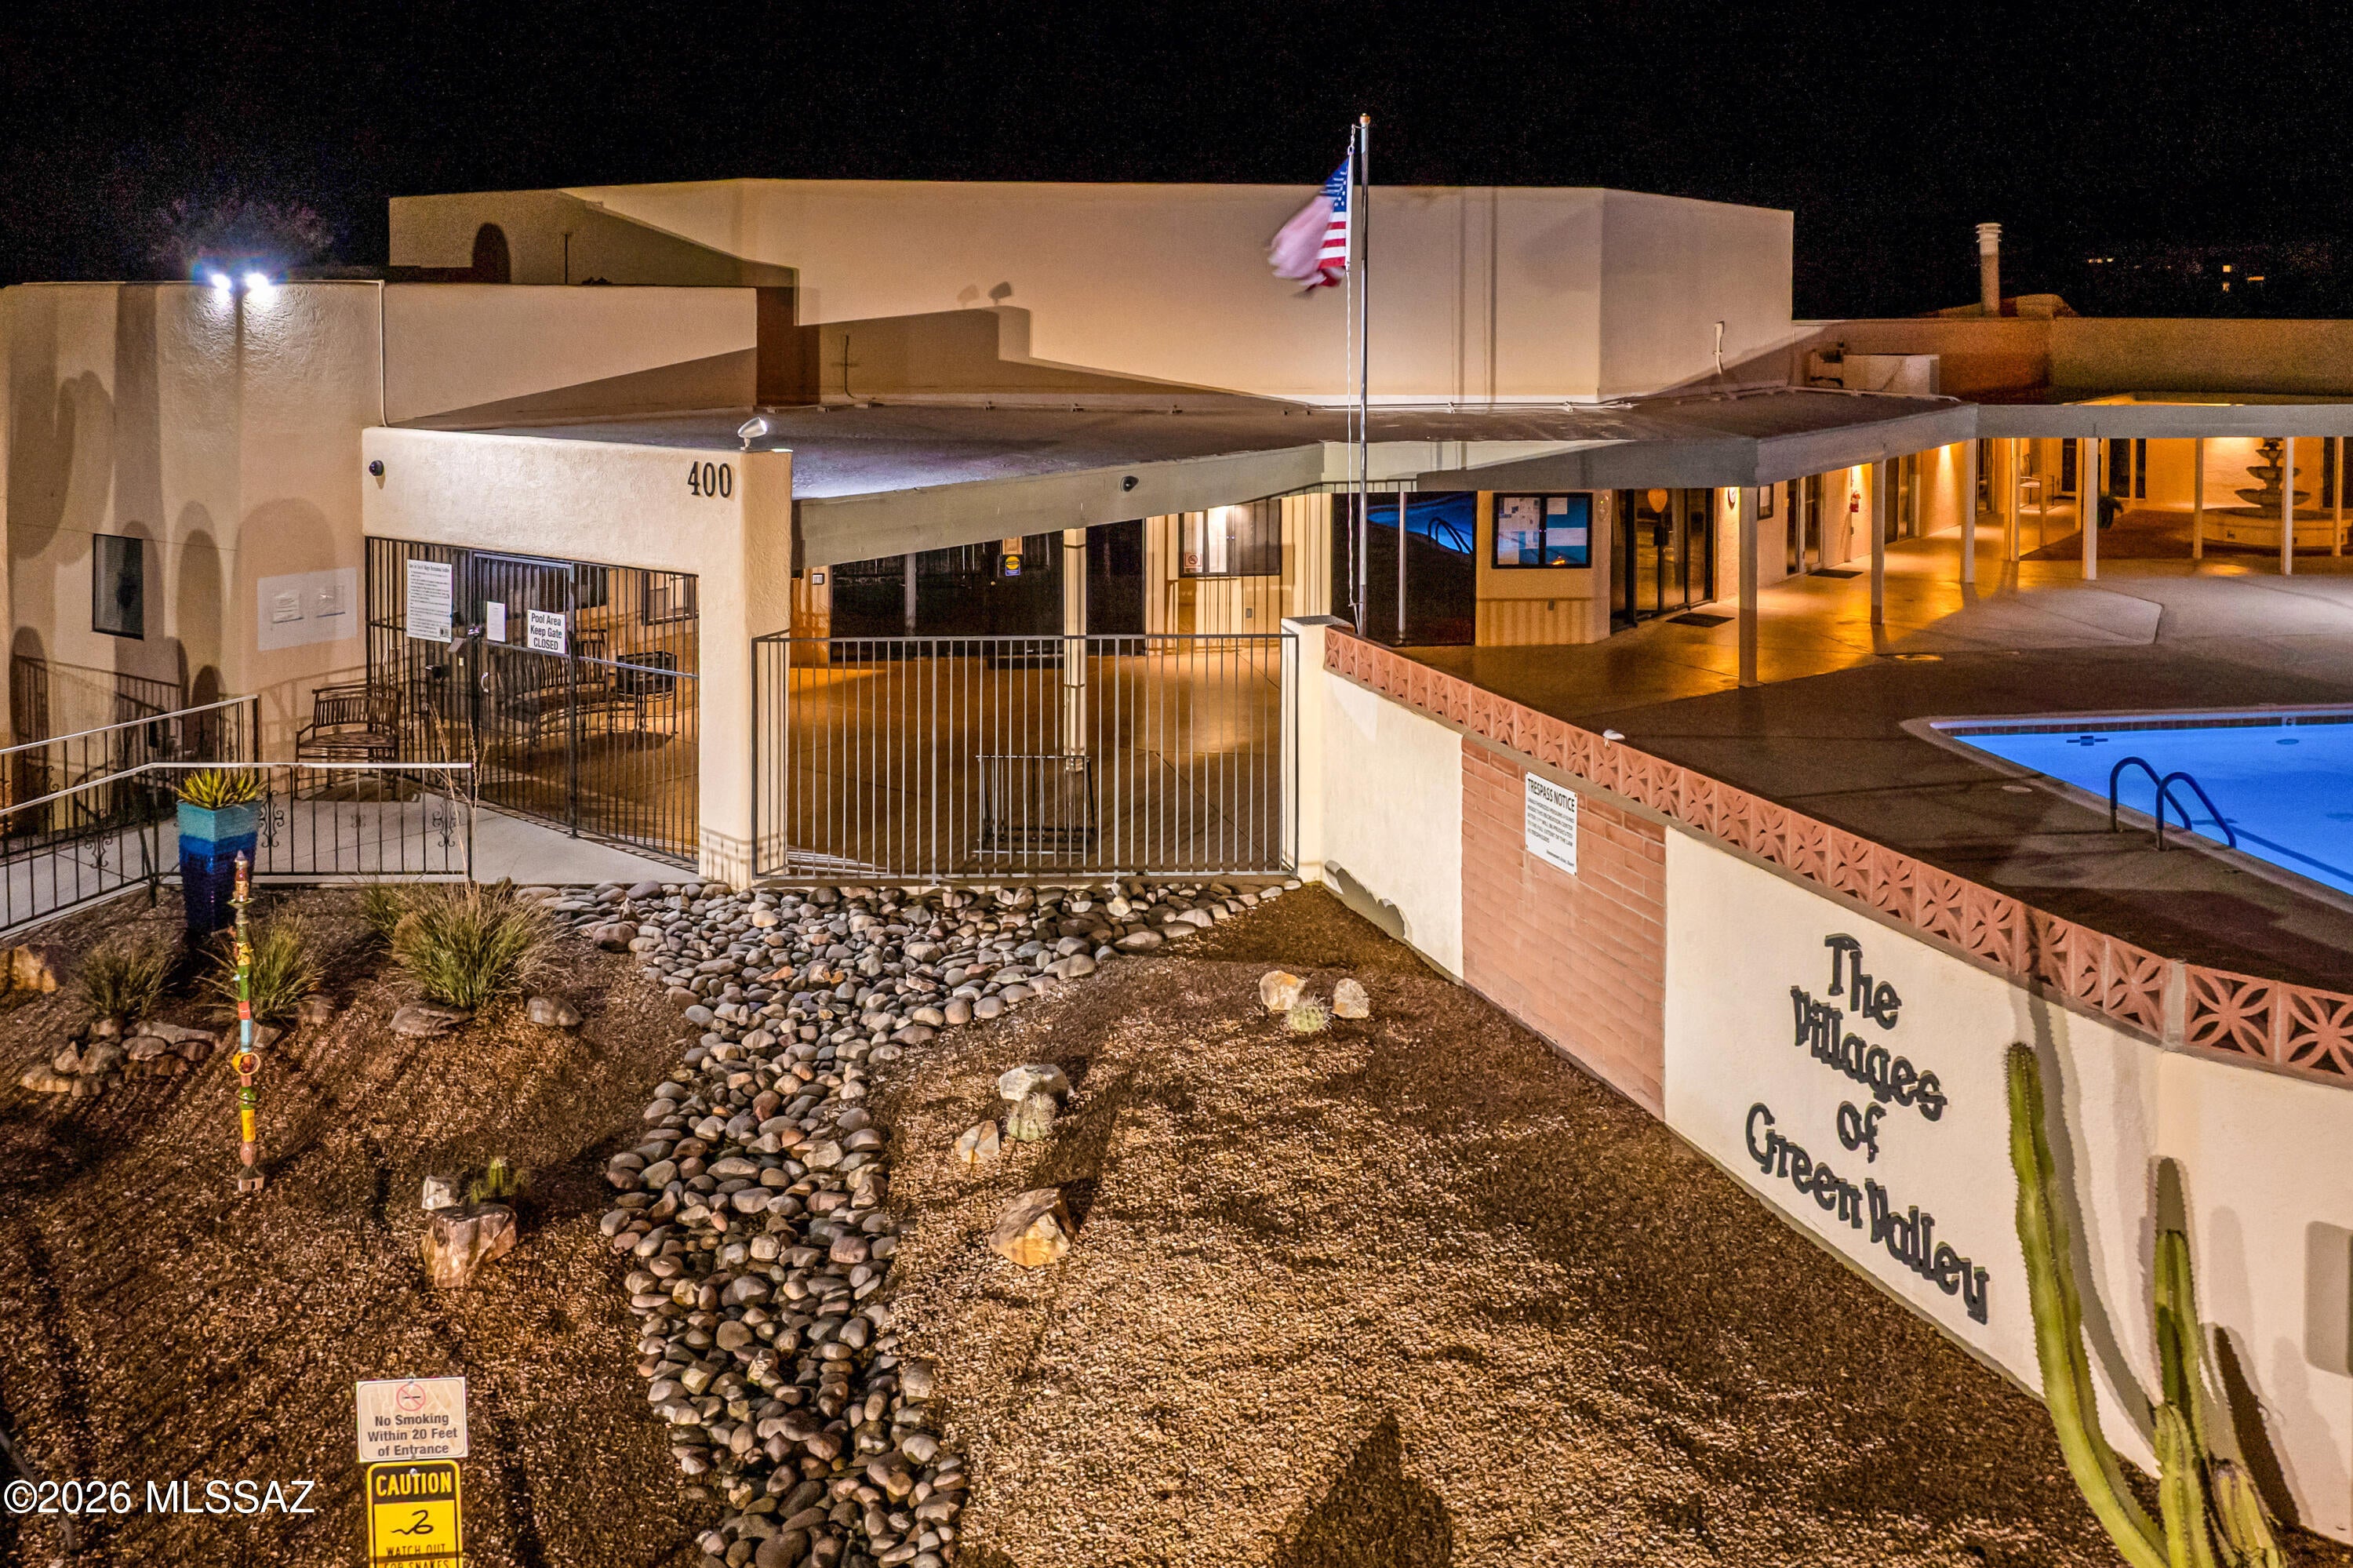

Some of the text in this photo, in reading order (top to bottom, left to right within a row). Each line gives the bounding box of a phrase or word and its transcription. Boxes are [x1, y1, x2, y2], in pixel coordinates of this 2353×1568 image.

[687, 460, 733, 499] 400
[532, 613, 562, 626] Pool Area
[531, 625, 562, 638] Keep Gate
[534, 638, 558, 650] CLOSED
[1528, 779, 1574, 812] TRESPASS NOTICE
[1824, 933, 1902, 1030] The
[1790, 985, 1947, 1122] Villages
[1746, 1102, 1990, 1325] Green Valley
[374, 1413, 449, 1427] No Smoking
[368, 1428, 458, 1442] Within 20 Feet
[377, 1443, 449, 1457] of Entrance
[376, 1472, 452, 1497] CAUTION
[386, 1544, 446, 1558] WATCH OUT
